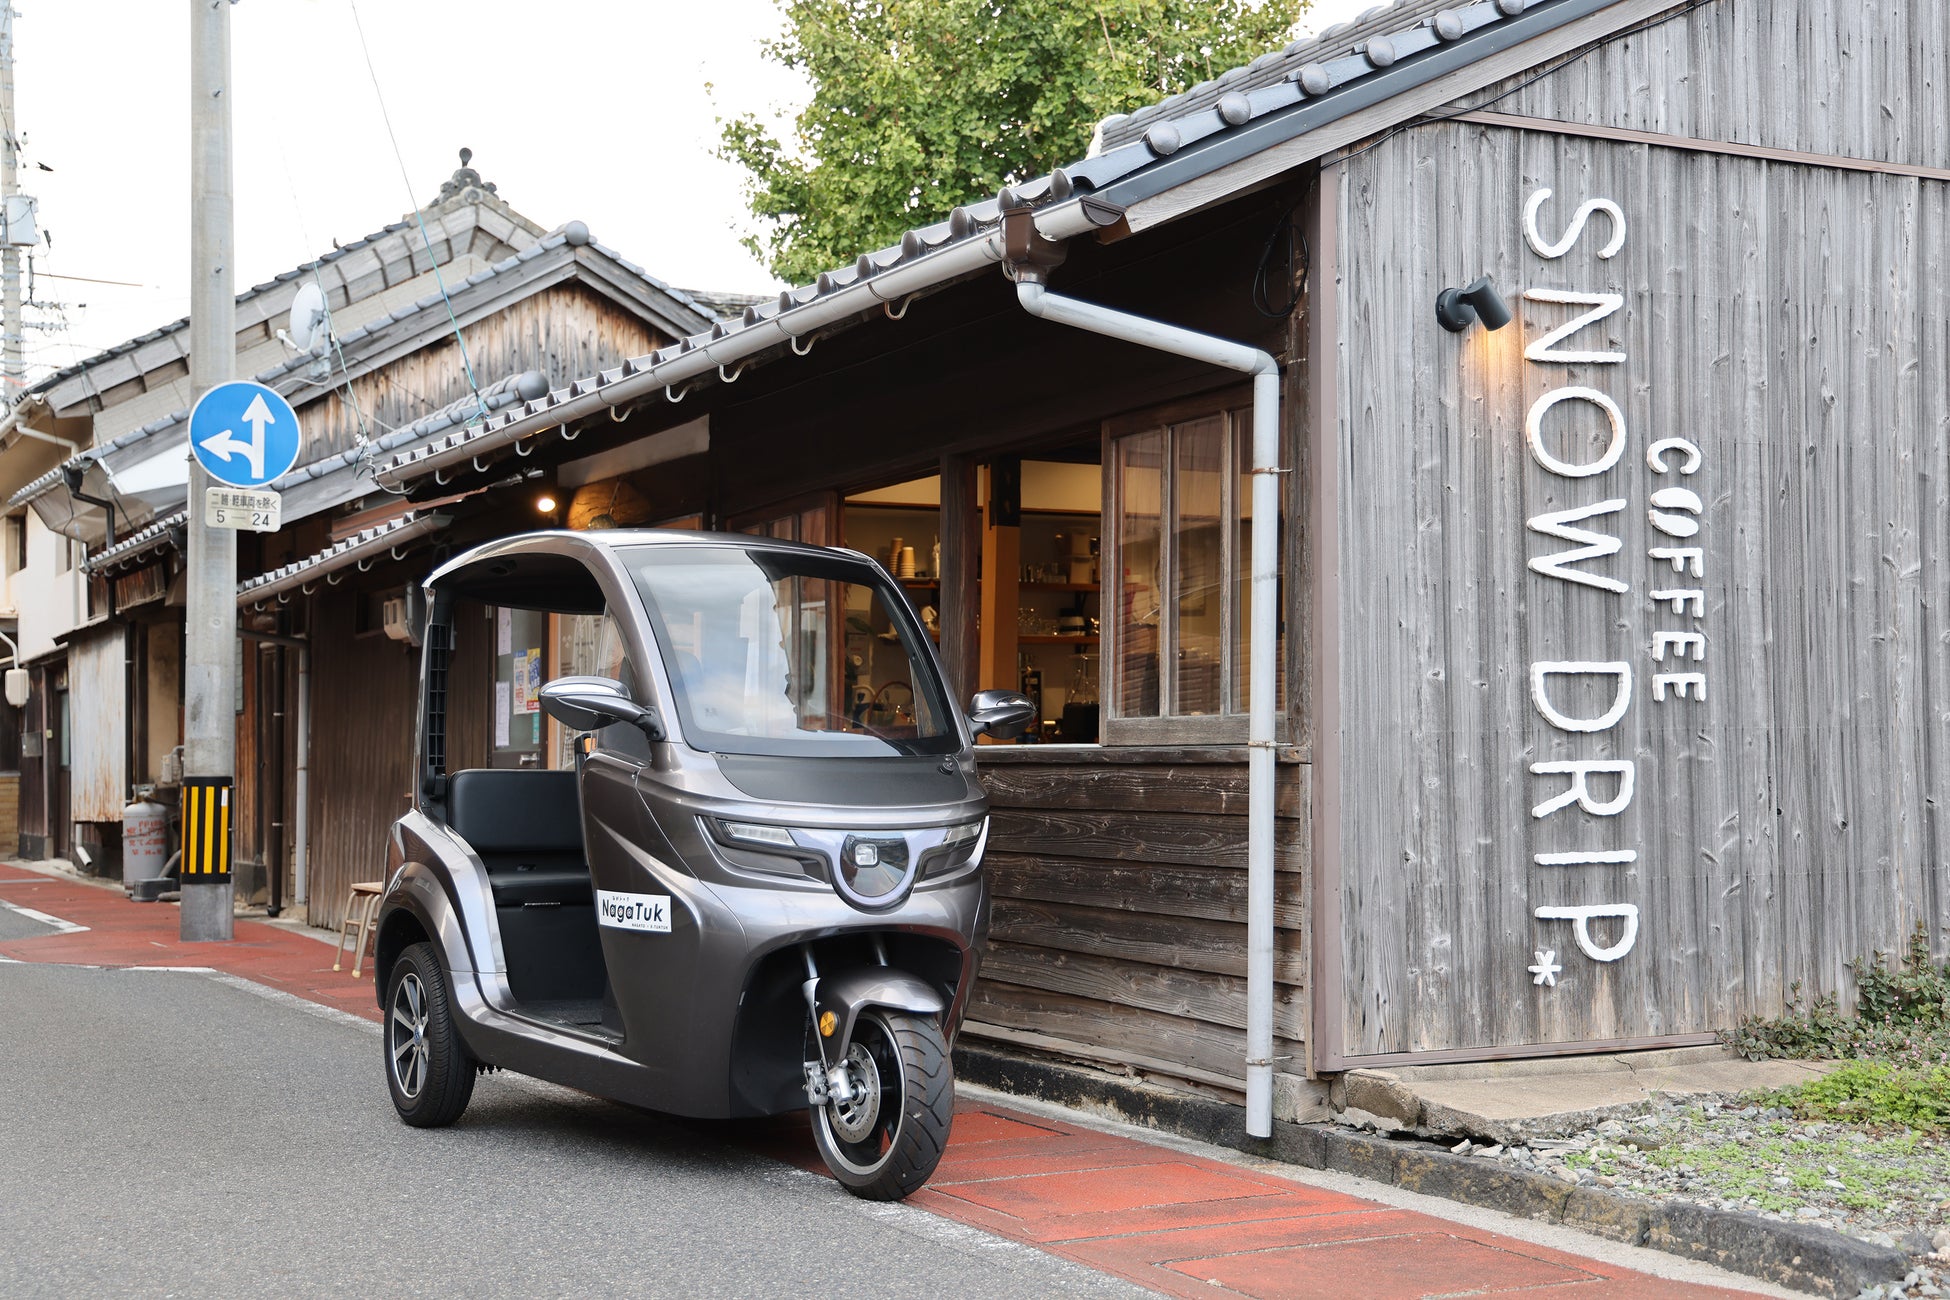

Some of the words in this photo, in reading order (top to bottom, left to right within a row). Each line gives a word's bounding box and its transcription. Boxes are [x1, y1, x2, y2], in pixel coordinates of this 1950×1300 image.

[216, 510, 225, 523] 5
[252, 512, 269, 526] 24
[1523, 188, 1629, 593] SNOW
[1646, 437, 1706, 702] COFFEE
[602, 898, 663, 923] NagaTuk
[1530, 661, 1639, 962] DRIP
